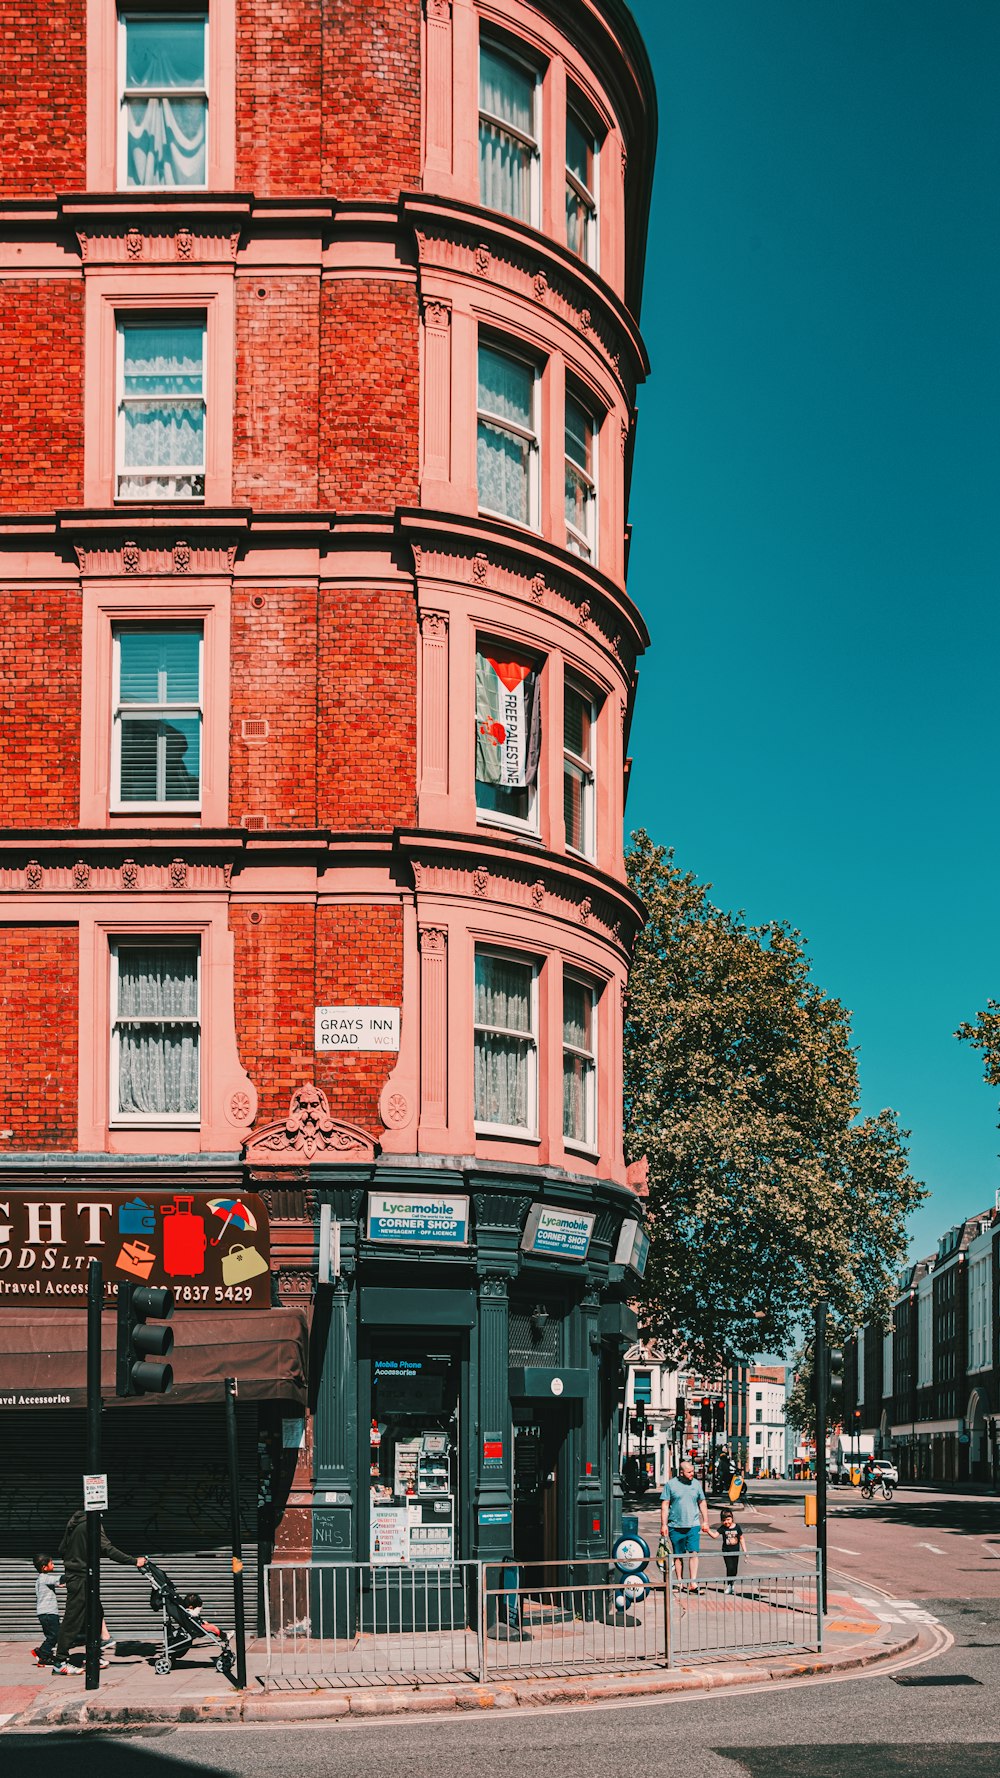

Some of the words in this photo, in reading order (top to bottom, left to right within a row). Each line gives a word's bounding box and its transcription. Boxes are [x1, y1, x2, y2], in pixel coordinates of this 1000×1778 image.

[505, 694, 517, 722] FREE
[506, 723, 519, 784] PALESTINE
[320, 1020, 363, 1030] GRAYS
[370, 1020, 393, 1030] INN
[322, 1034, 358, 1044] ROAD
[382, 1201, 454, 1215] Lycamobile
[378, 1218, 424, 1228] CORNER
[428, 1220, 458, 1230] SHOP
[542, 1214, 588, 1232] Lycamobile
[538, 1231, 566, 1242] CORNER
[568, 1236, 586, 1245] SHOP
[174, 1286, 210, 1300] 7837
[214, 1286, 252, 1302] 5429
[18, 1394, 70, 1404] Accessories
[316, 1529, 343, 1544] NHS
